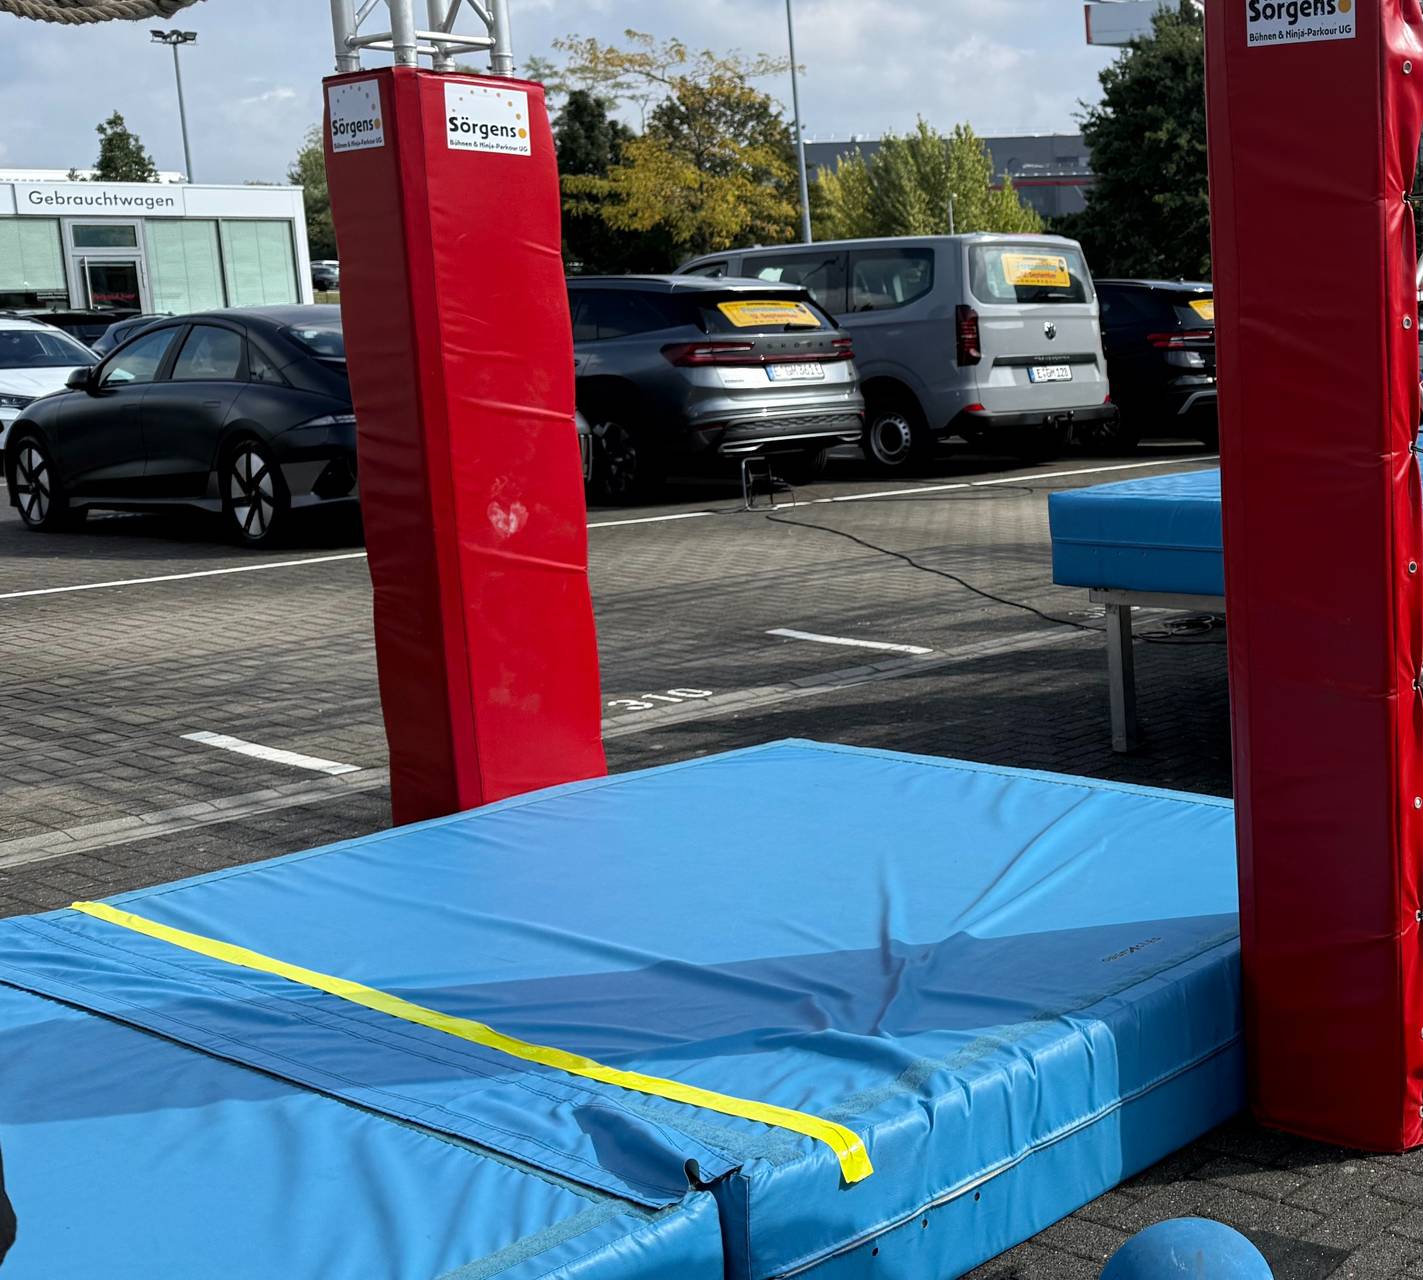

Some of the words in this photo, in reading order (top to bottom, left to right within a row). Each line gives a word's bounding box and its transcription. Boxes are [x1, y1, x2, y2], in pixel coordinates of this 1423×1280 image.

[1249, 32, 1276, 42] Bühnen
[1278, 31, 1284, 40] &
[1339, 24, 1352, 34] UG
[332, 117, 374, 138] Sörgens
[448, 116, 517, 140] Sörgens
[28, 190, 174, 209] Gebrauchtwagen
[607, 687, 713, 711] 310
